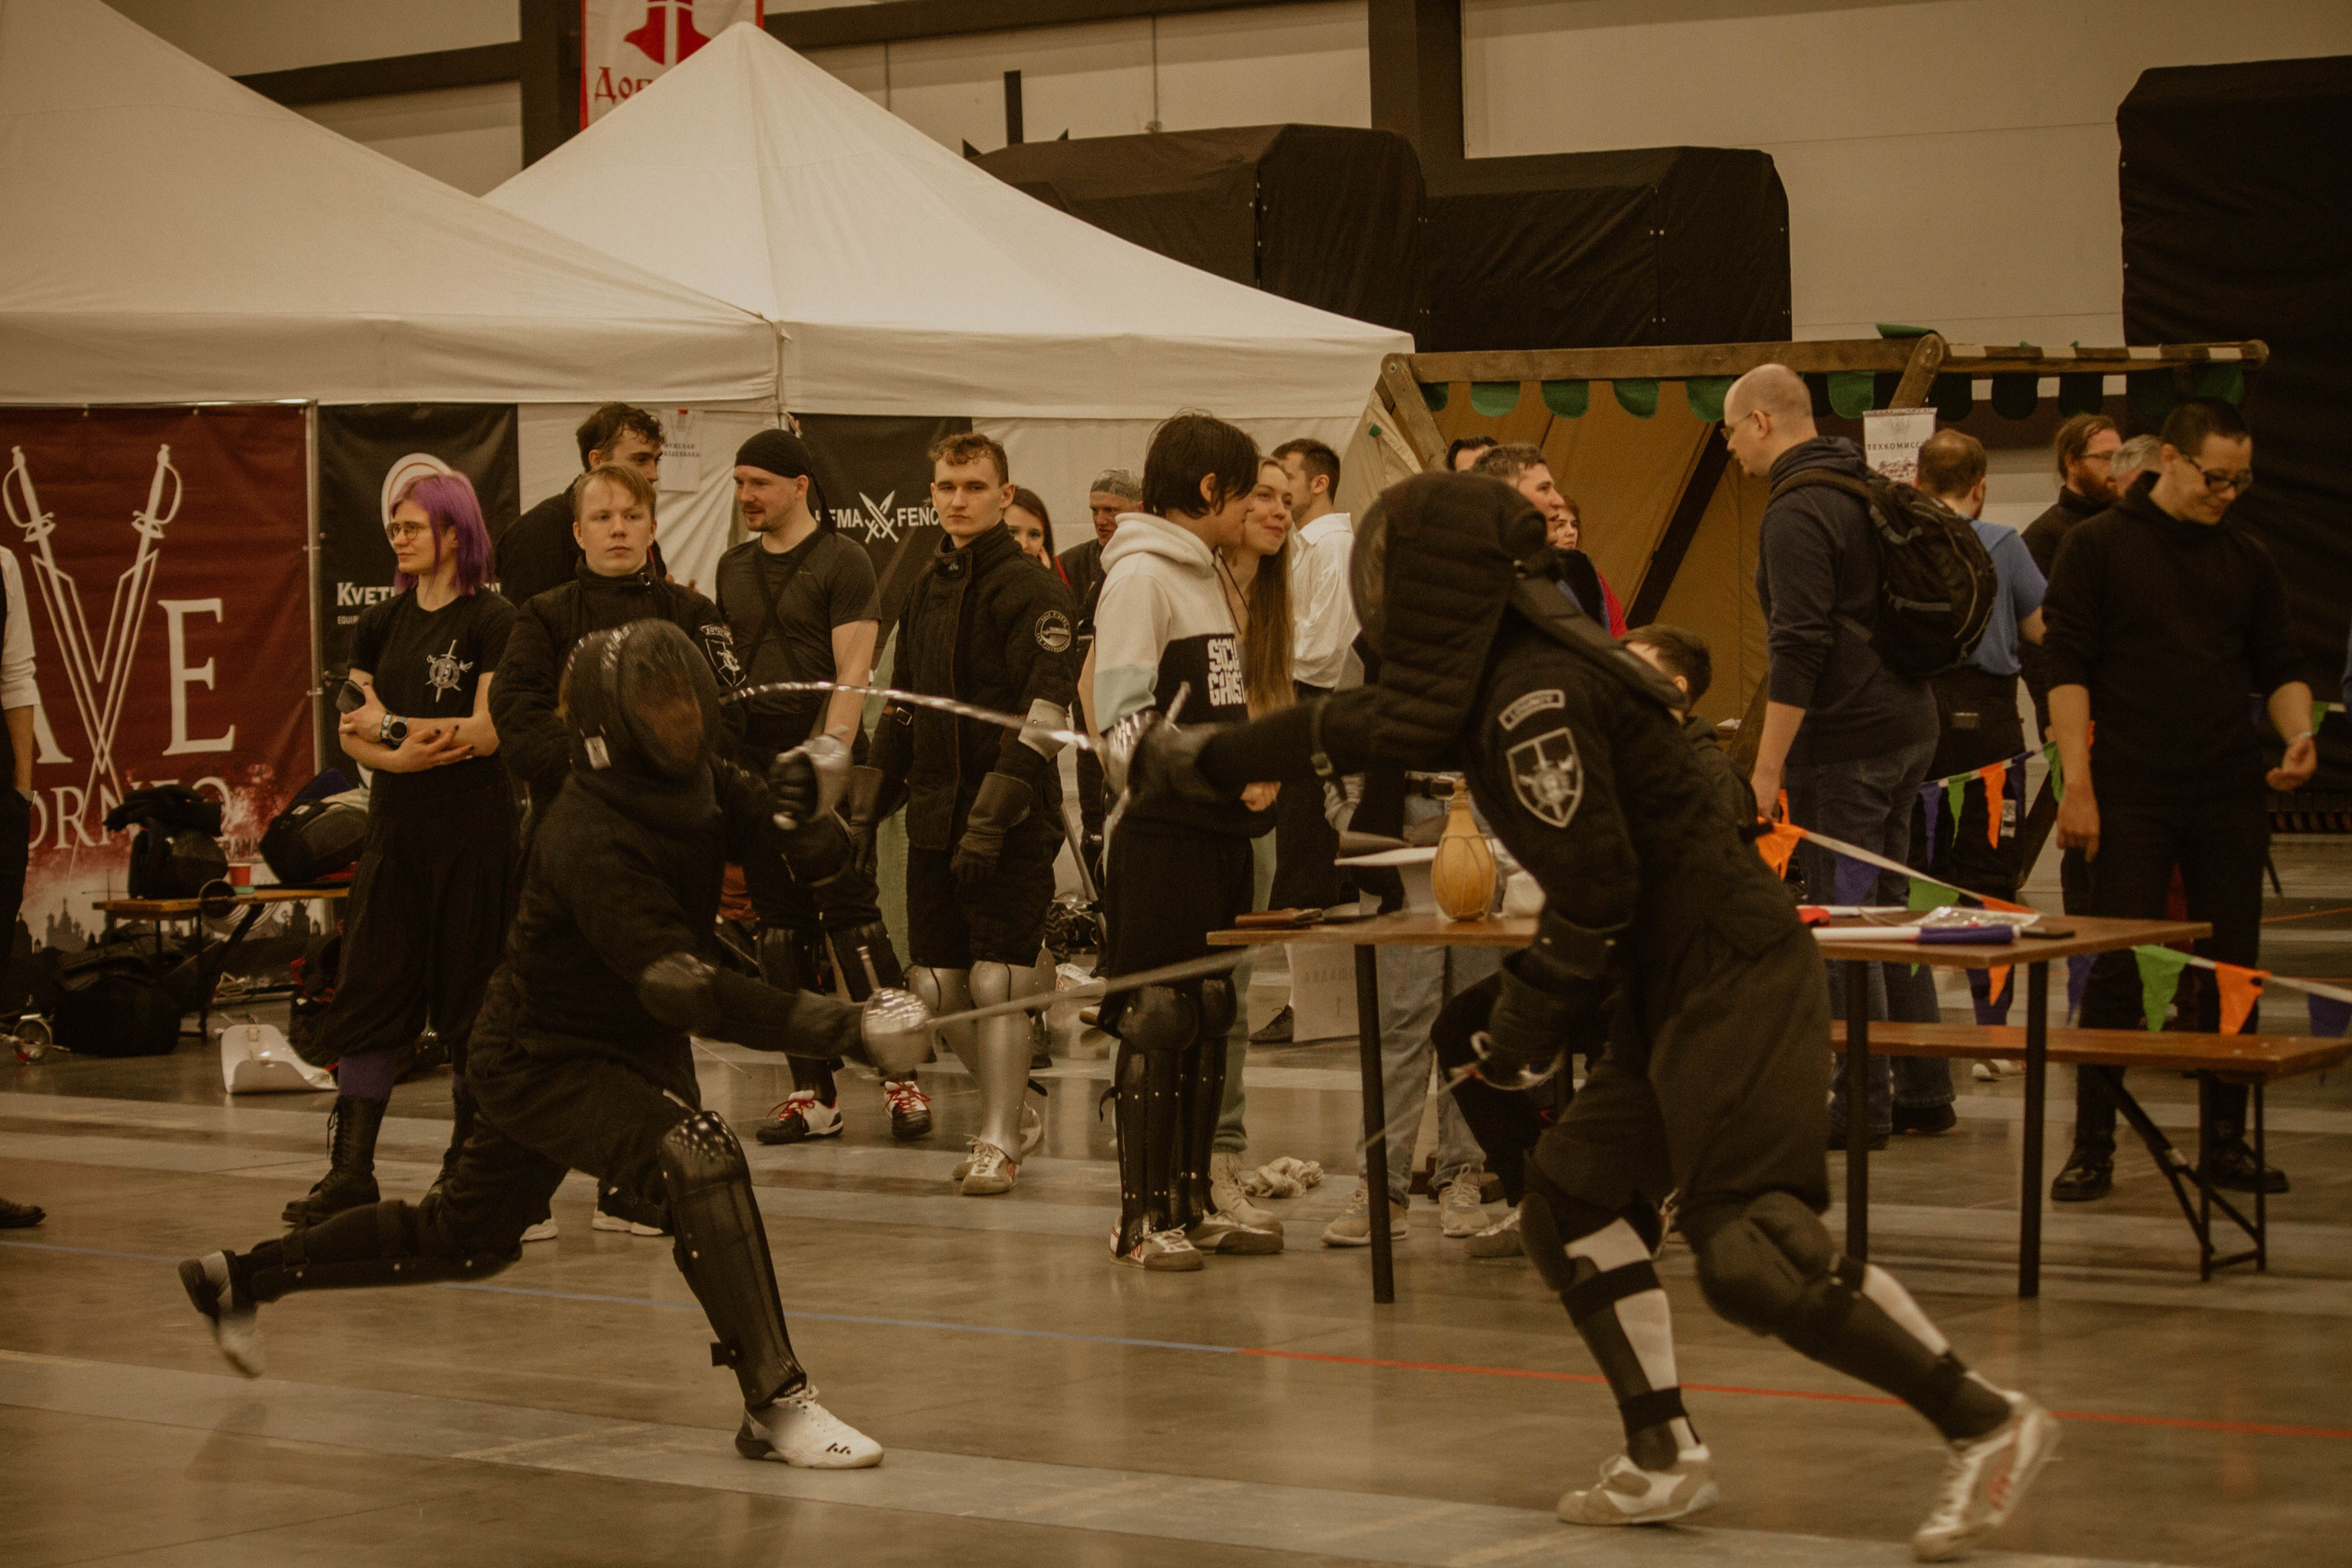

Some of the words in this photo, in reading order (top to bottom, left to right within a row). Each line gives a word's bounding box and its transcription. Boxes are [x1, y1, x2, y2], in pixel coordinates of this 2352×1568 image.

[1867, 441, 1925, 451] ТЕХКОМИСС
[897, 506, 940, 527] FENC
[336, 581, 396, 606] KVET
[337, 615, 359, 626] EQUIP
